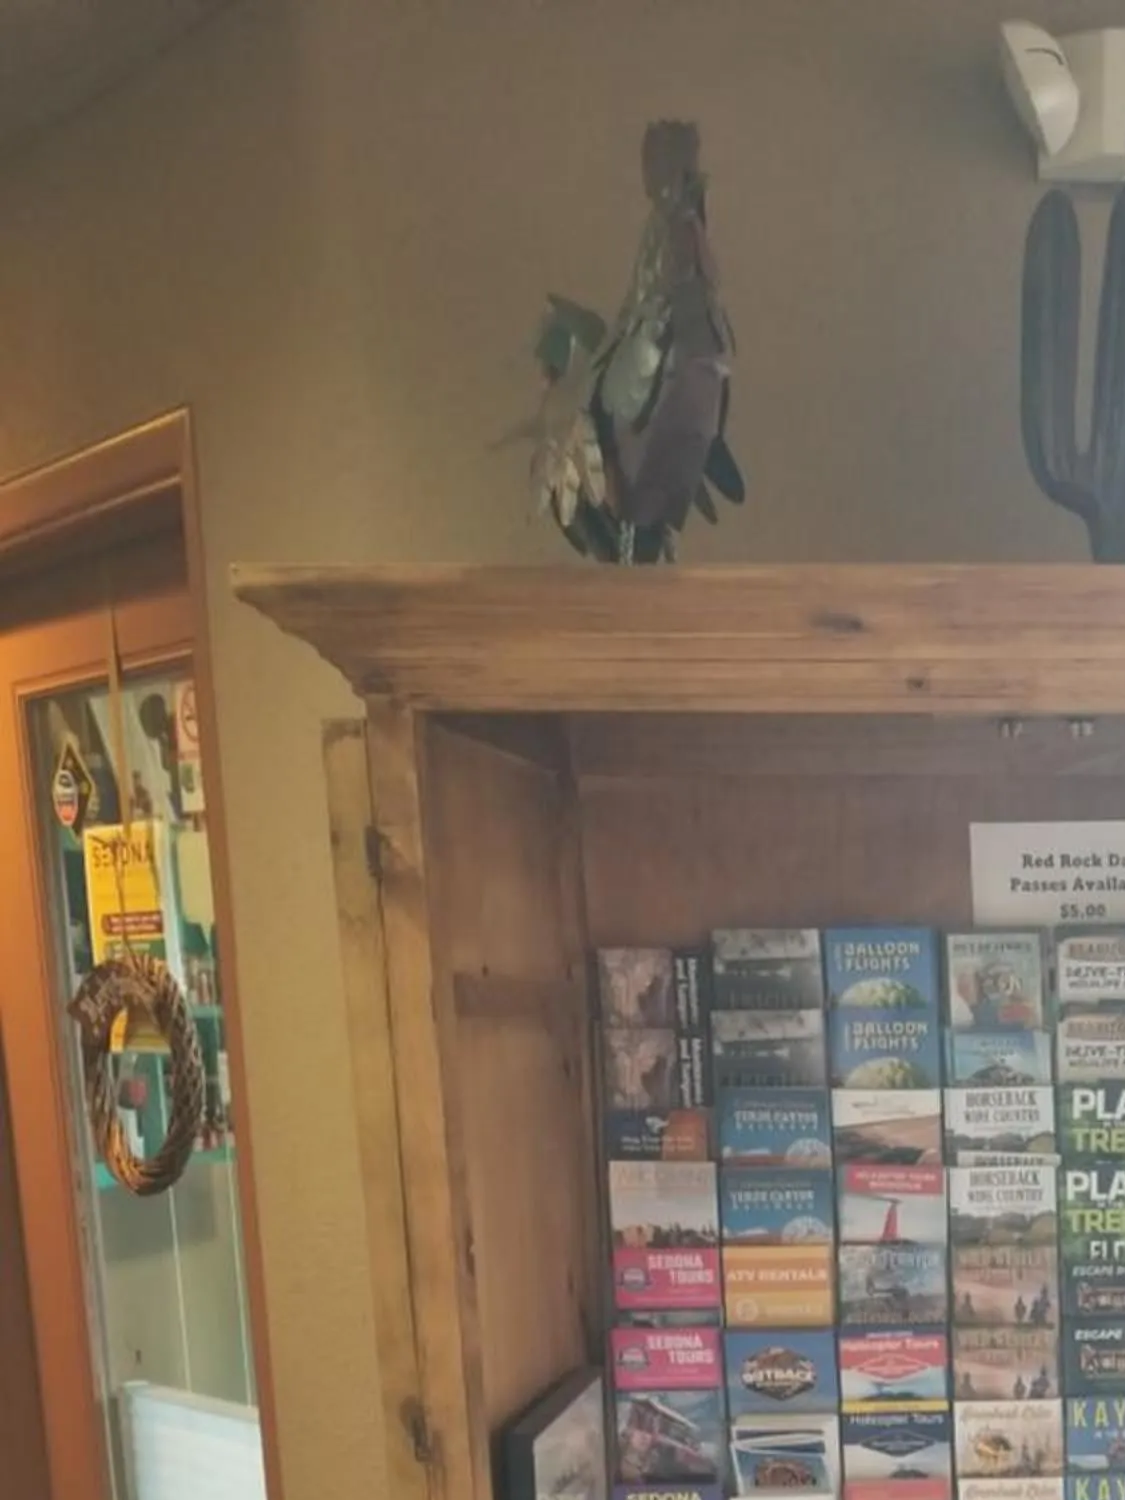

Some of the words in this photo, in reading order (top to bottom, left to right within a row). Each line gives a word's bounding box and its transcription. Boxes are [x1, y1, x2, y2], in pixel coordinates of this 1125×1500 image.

[1020, 853, 1055, 870] Red
[1060, 852, 1102, 869] Rock
[1010, 877, 1068, 893] Passes
[1059, 902, 1108, 919] $5.00
[843, 941, 921, 956] BALLOON
[845, 956, 911, 972] FLIGHTS
[851, 1020, 929, 1035] BALLOON
[852, 1036, 920, 1051] FLIGHTS
[647, 1254, 704, 1270] SEDONA
[669, 1270, 715, 1285] TOURS
[726, 1269, 757, 1281] ATV
[759, 1268, 829, 1281] RENTALS
[646, 1334, 704, 1350] SEDONA
[1074, 1329, 1123, 1341] ESCAPE
[668, 1350, 715, 1365] TOURS
